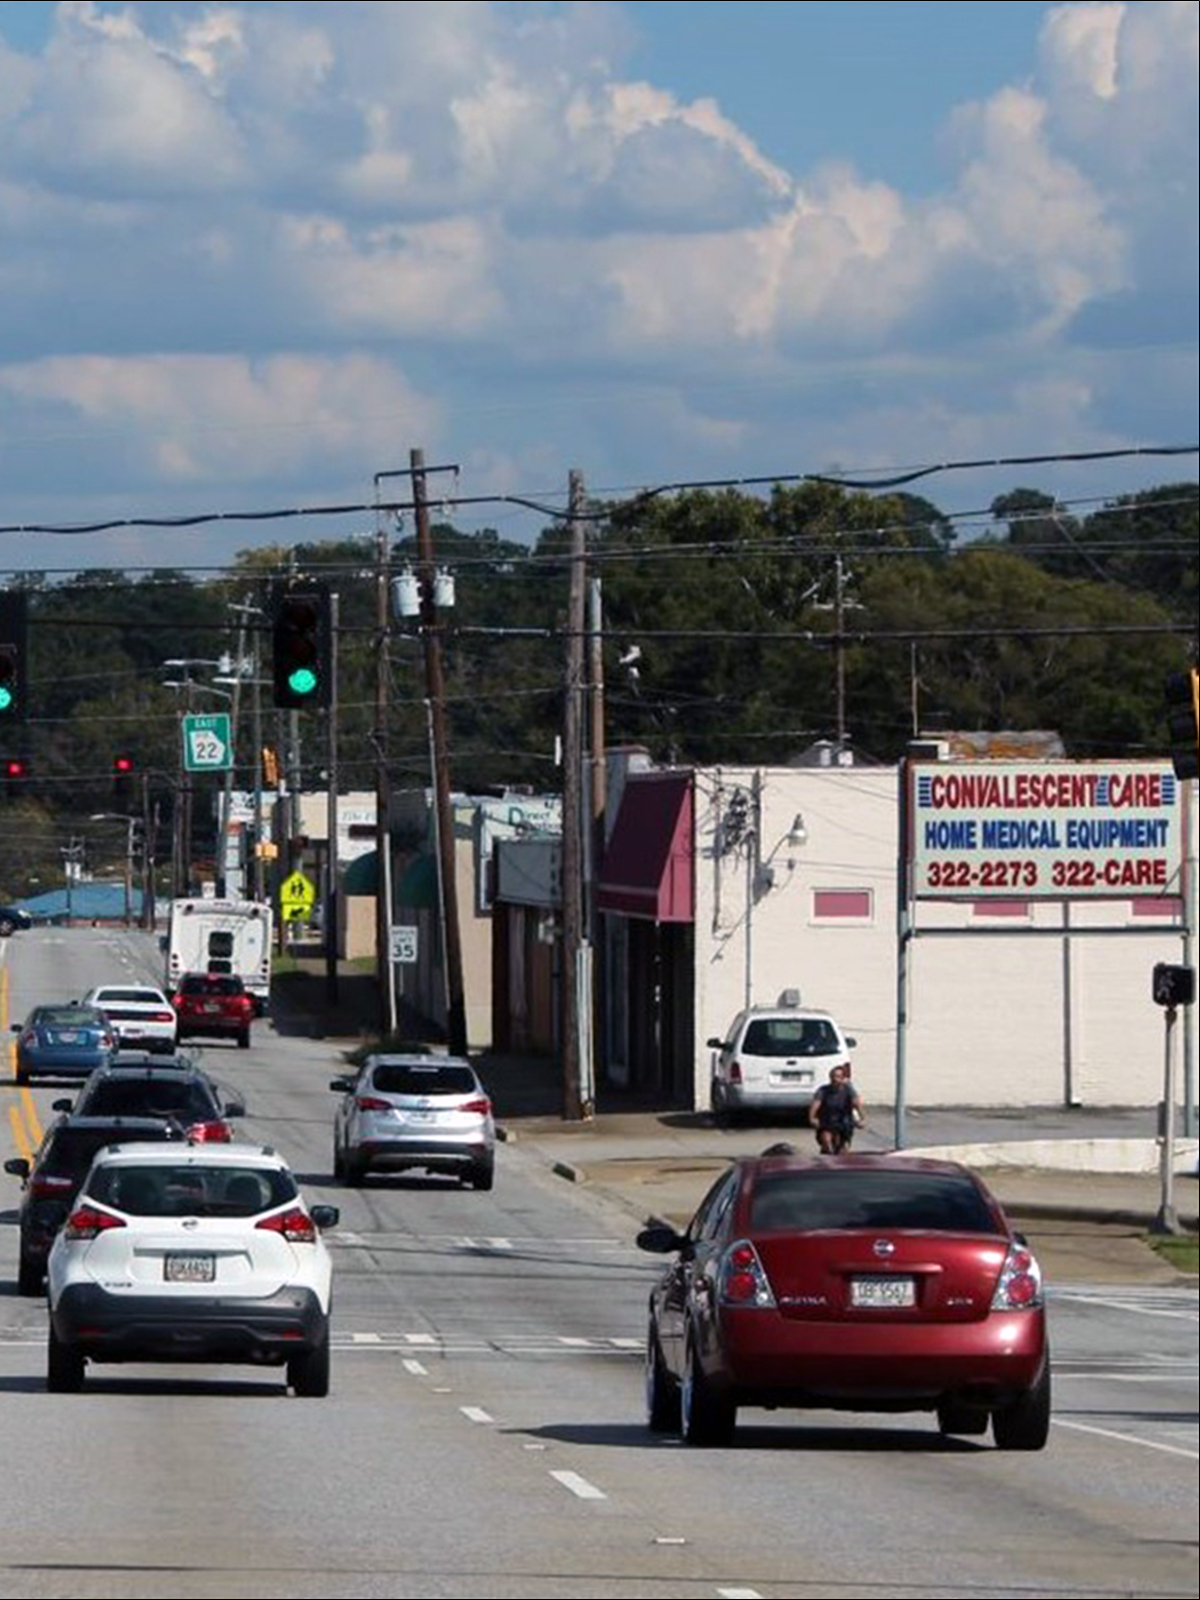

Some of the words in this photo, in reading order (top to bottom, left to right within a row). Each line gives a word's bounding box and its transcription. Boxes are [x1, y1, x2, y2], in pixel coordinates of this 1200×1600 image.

[194, 718, 217, 729] EAST
[196, 742, 218, 760] 22
[931, 773, 1099, 809] CONVALESCENT
[1108, 773, 1161, 809] CARE
[925, 820, 978, 851] HOME
[982, 820, 1061, 850] MEDICAL
[1066, 819, 1170, 851] EQUIPMENT
[927, 860, 1038, 888] 322-2273
[1052, 859, 1167, 887] 322-CARE
[393, 944, 414, 959] 35
